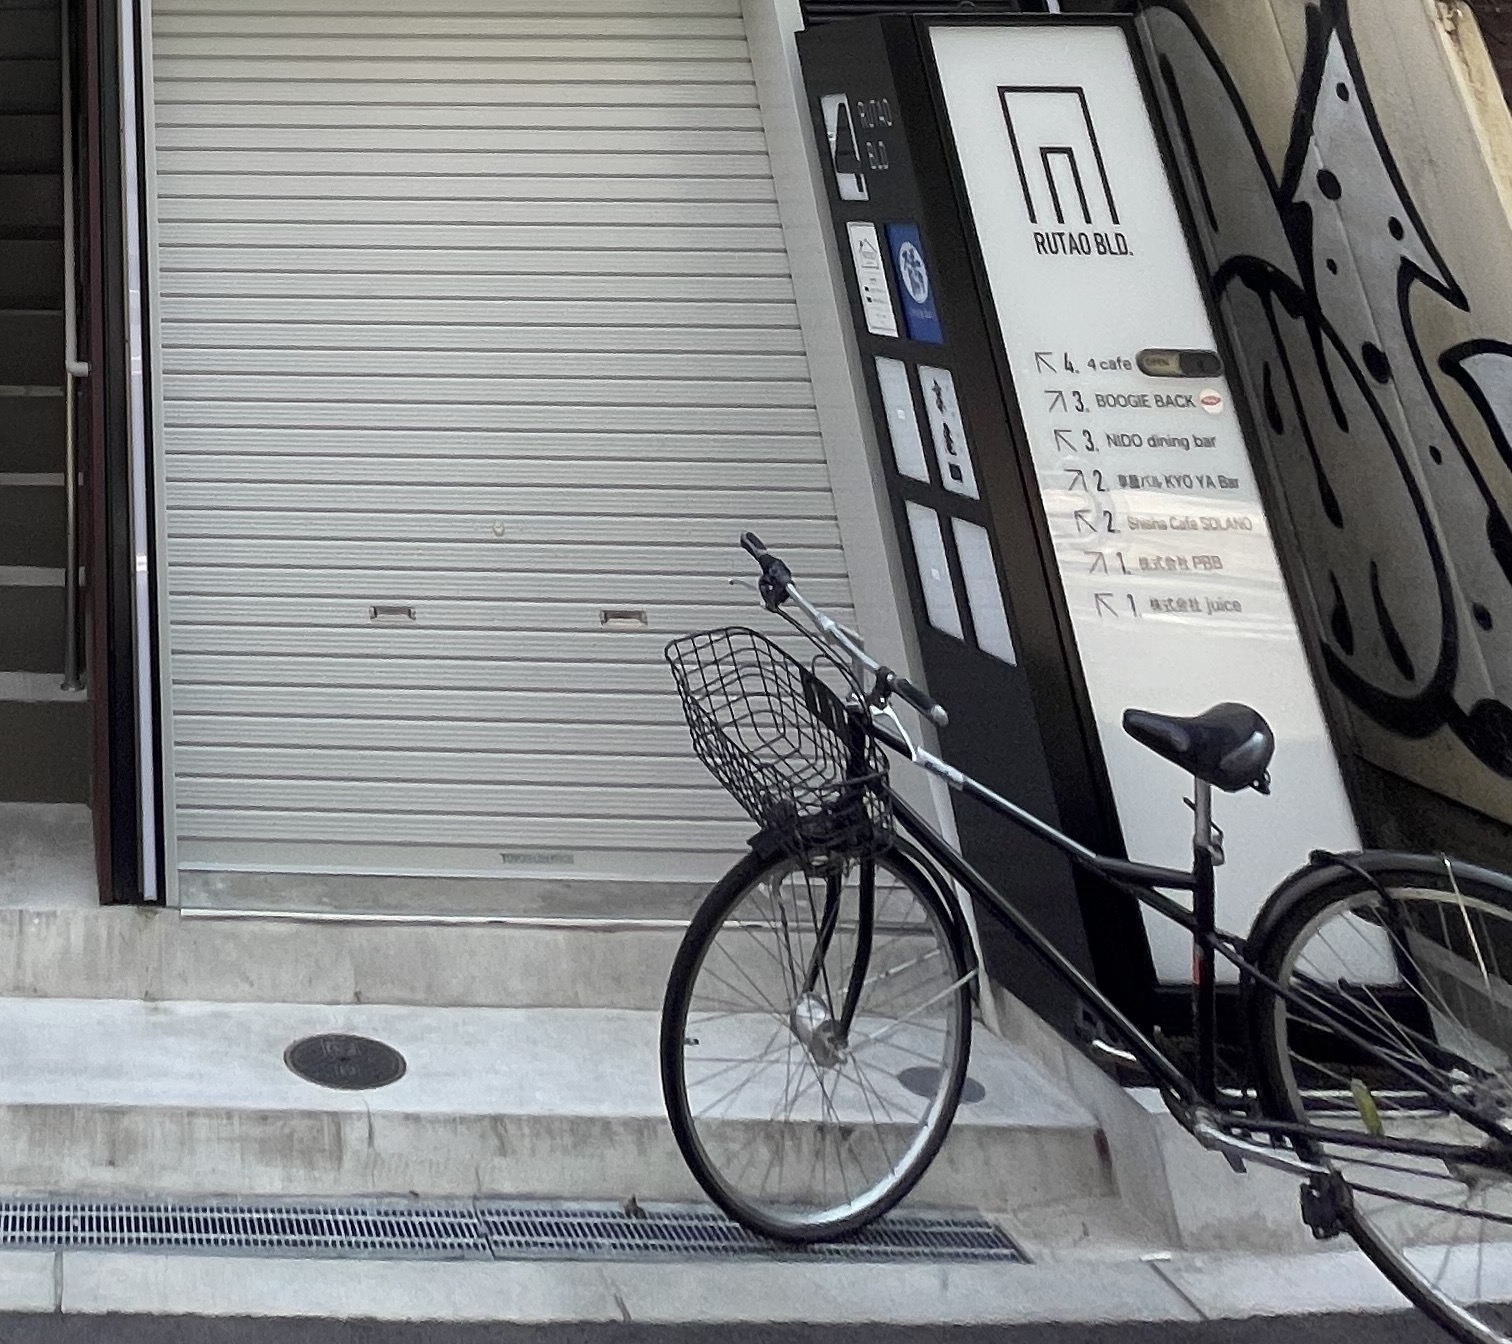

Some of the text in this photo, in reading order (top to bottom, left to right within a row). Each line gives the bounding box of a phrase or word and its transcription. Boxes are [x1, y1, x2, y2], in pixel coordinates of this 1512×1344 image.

[1034, 231, 1134, 256] RUTAO BLD.
[1064, 352, 1080, 374] 4.
[1100, 356, 1132, 371] cafe
[1095, 393, 1149, 409] BOOGIE
[1154, 394, 1197, 409] BACK
[1104, 433, 1143, 449] NIDO
[1147, 433, 1190, 451] dining
[1193, 434, 1217, 449] bar
[1164, 473, 1194, 490] KYO
[1195, 474, 1217, 490] YA
[1205, 596, 1242, 616] juice
